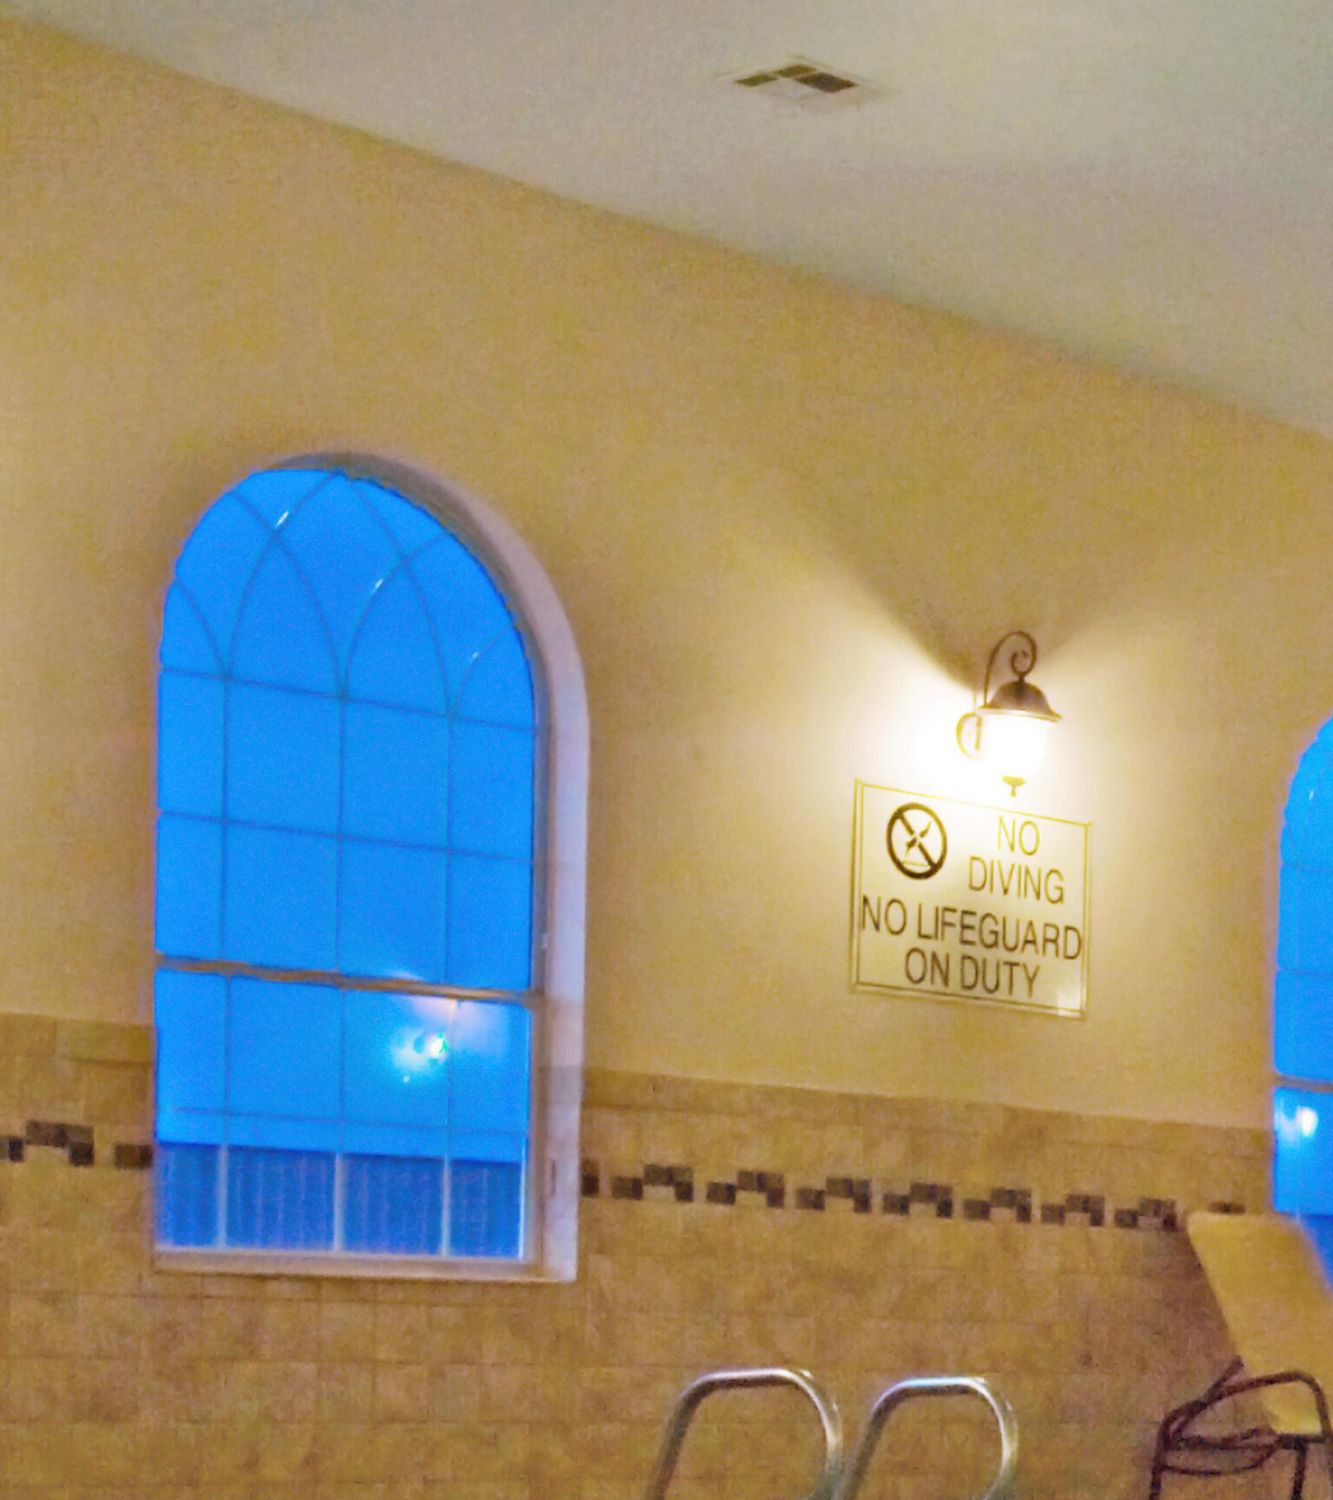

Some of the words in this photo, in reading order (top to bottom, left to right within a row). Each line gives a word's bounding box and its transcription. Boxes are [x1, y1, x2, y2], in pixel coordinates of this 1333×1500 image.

[998, 816, 1041, 856] NO
[968, 855, 1065, 905] DIVING
[861, 894, 908, 936] NO
[917, 903, 1083, 961] LIFEGUARD
[904, 947, 951, 988] ON
[960, 955, 1041, 998] DUTY
